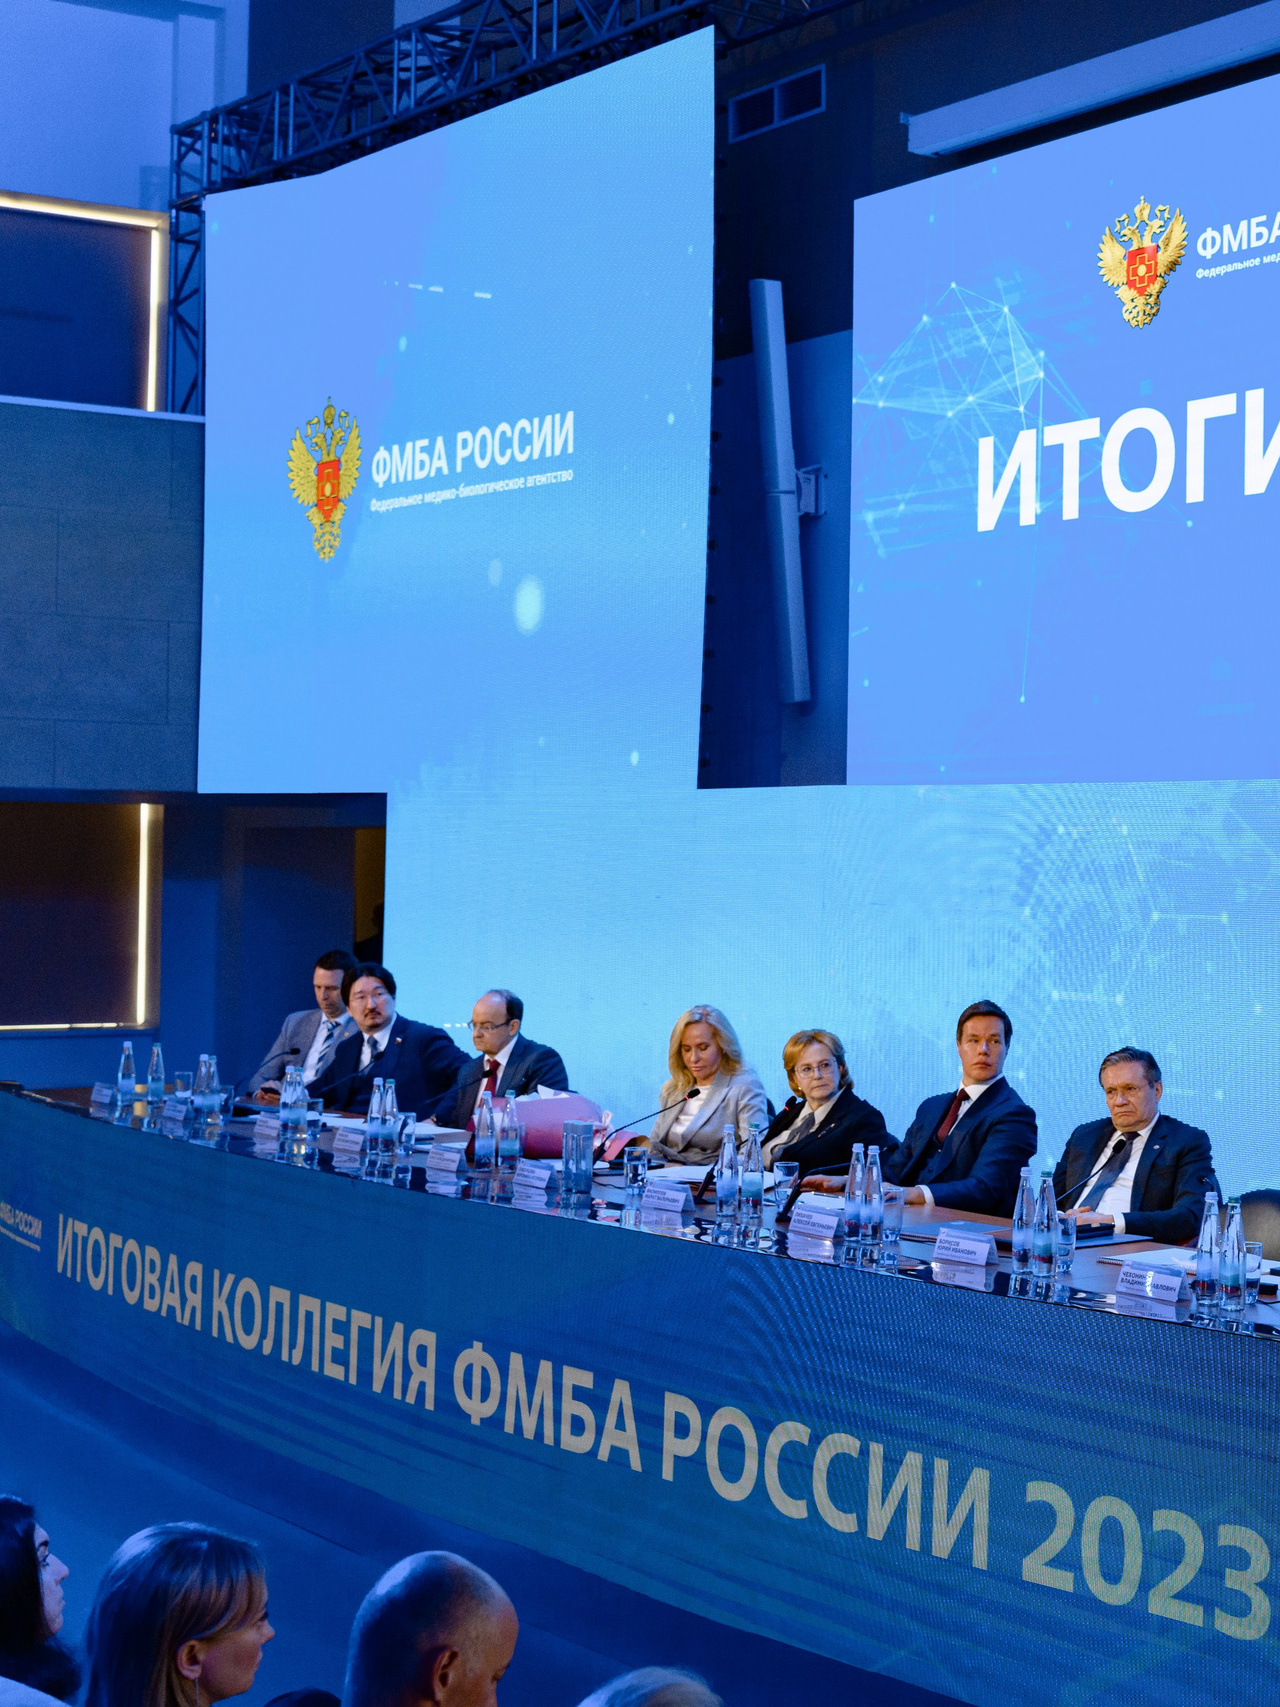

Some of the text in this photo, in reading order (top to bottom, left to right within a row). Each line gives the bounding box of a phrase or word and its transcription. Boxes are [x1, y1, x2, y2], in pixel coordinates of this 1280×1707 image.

[1196, 256, 1261, 279] Федеральное
[372, 411, 574, 488] ФМБА РОССИИ
[370, 470, 574, 513] Федеральное медико-биологическое агентство
[938, 1238, 960, 1247] БОРИСОВ
[951, 1247, 977, 1256] ИВАНОВИЧ
[1120, 1277, 1149, 1287] ВЛАДИМИ
[1150, 1282, 1177, 1292] АВЛОВИЧ
[1122, 1271, 1147, 1280] ЧЕХОНИН
[57, 1213, 1273, 1641] ИТОГОВАЯ КОЛЛЕГИЯ ФМБА РОССИИ 2023
